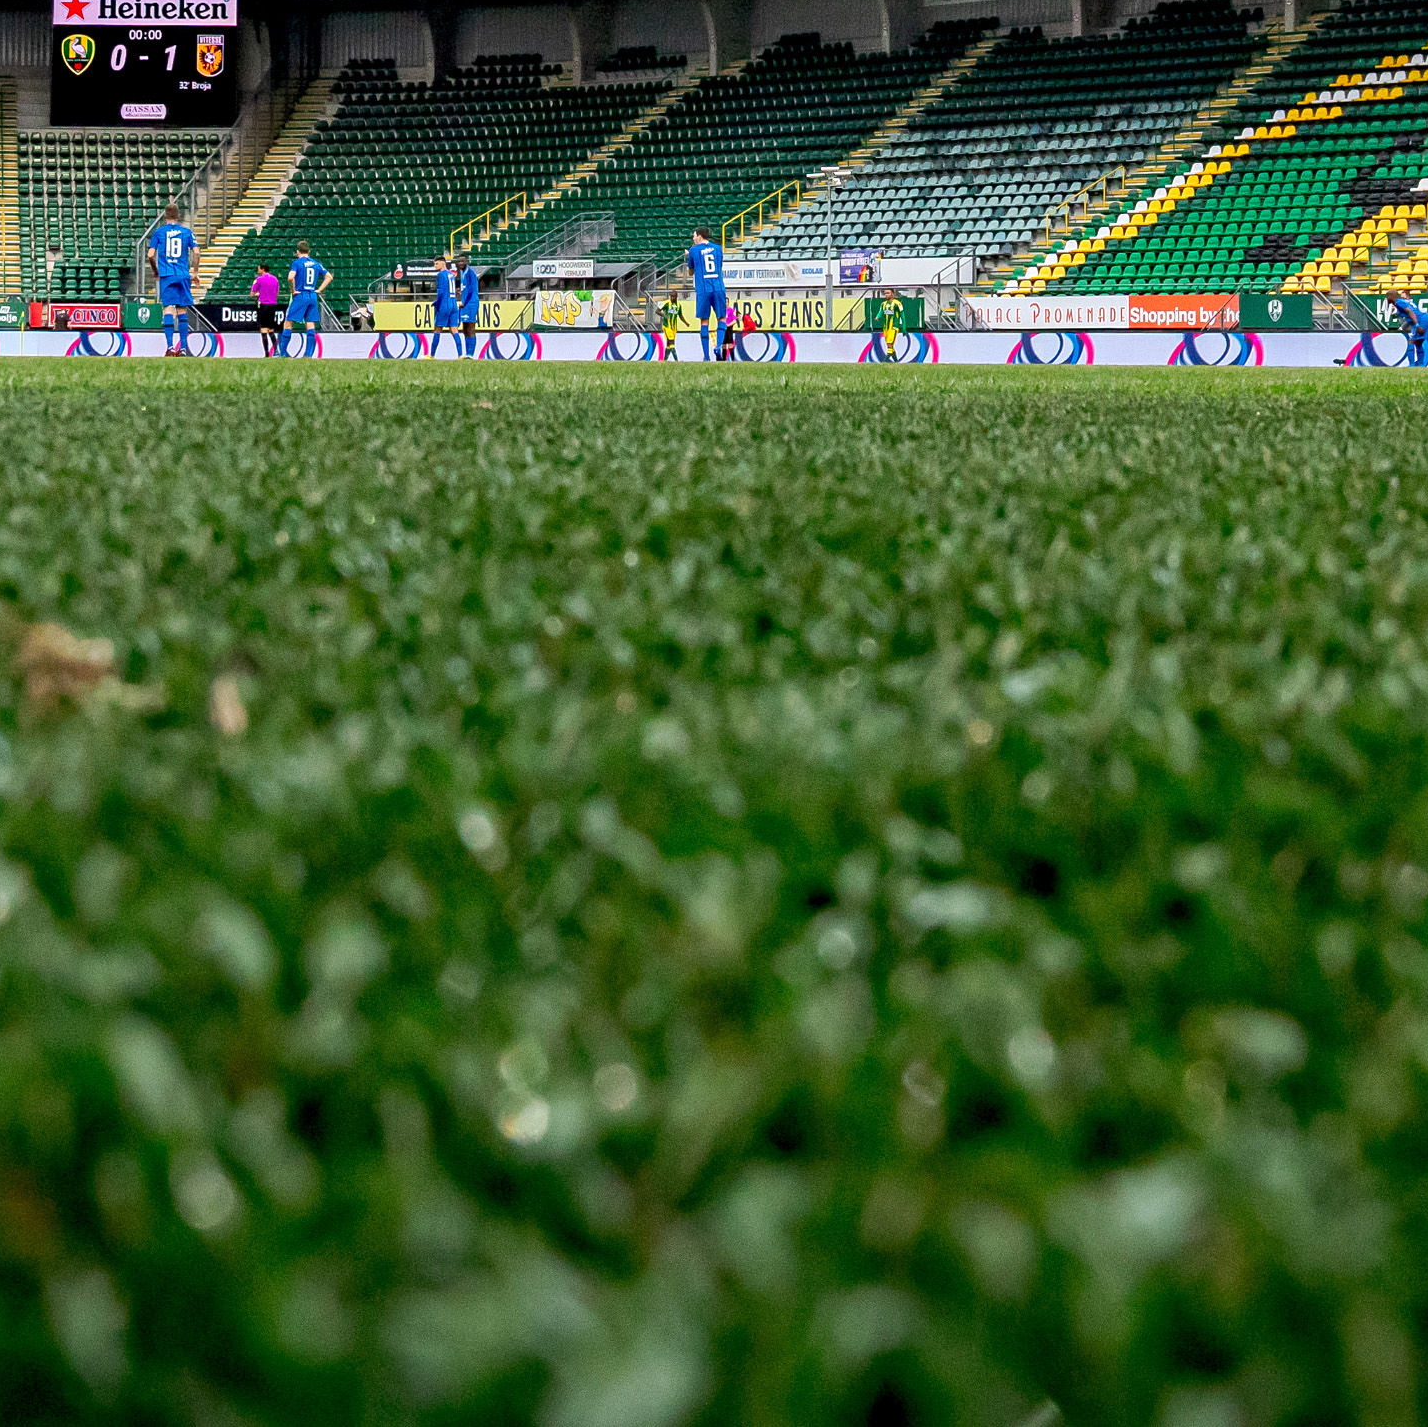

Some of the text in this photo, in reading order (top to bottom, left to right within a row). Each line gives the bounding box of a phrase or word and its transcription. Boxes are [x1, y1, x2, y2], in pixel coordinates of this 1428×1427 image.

[128, 29, 163, 40] 00:00
[110, 44, 127, 71] 0
[164, 44, 177, 71] 1
[191, 81, 211, 91] Broja
[165, 237, 182, 257] 18
[704, 254, 715, 272] 6
[306, 267, 314, 285] 8
[73, 309, 116, 323] CINCO
[221, 306, 284, 325] Dusserp
[733, 301, 823, 328] ARS JEANS
[1029, 302, 1126, 324] PROMENADE
[1130, 306, 1196, 326] Shopping
[1199, 306, 1218, 326] by
